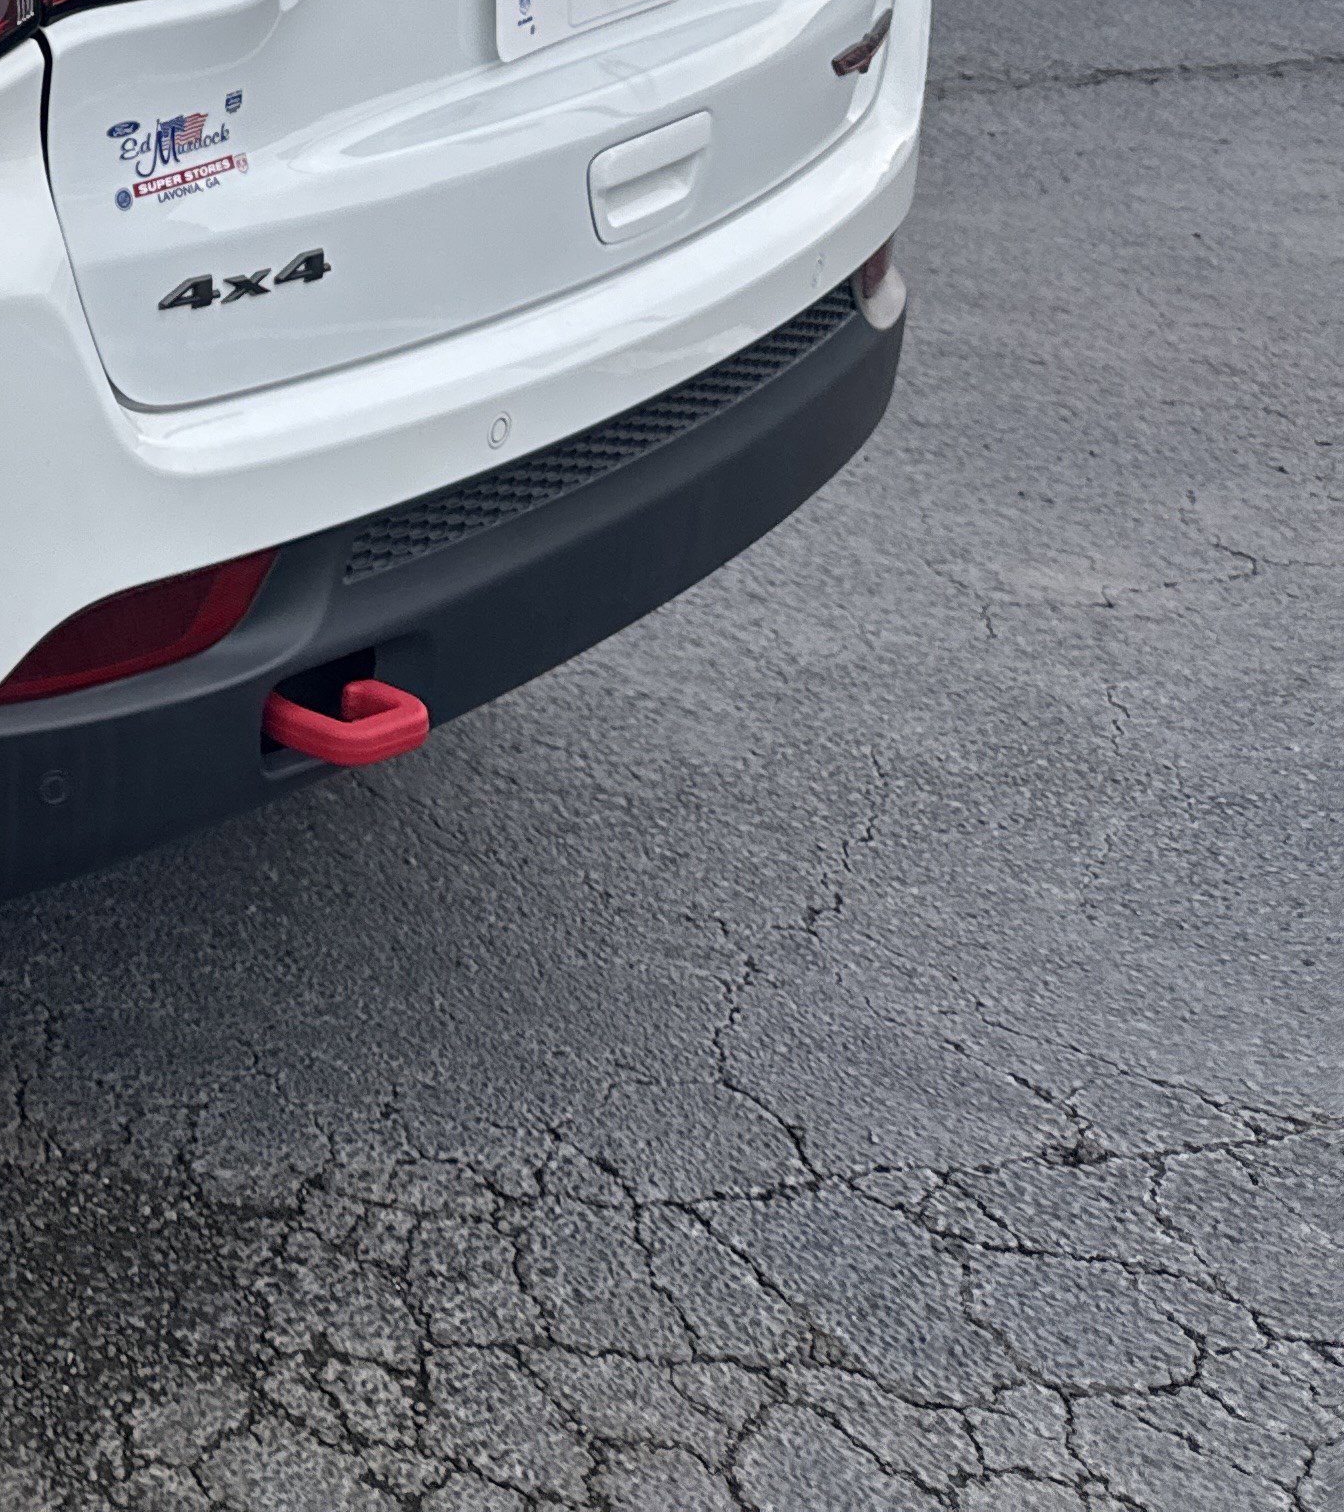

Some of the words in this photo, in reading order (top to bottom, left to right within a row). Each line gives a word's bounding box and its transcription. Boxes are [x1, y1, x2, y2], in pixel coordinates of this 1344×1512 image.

[119, 133, 151, 160] Ed
[136, 123, 230, 178] Murdock
[137, 169, 183, 195] SUPER
[185, 159, 231, 183] STORES
[205, 176, 221, 189] GA
